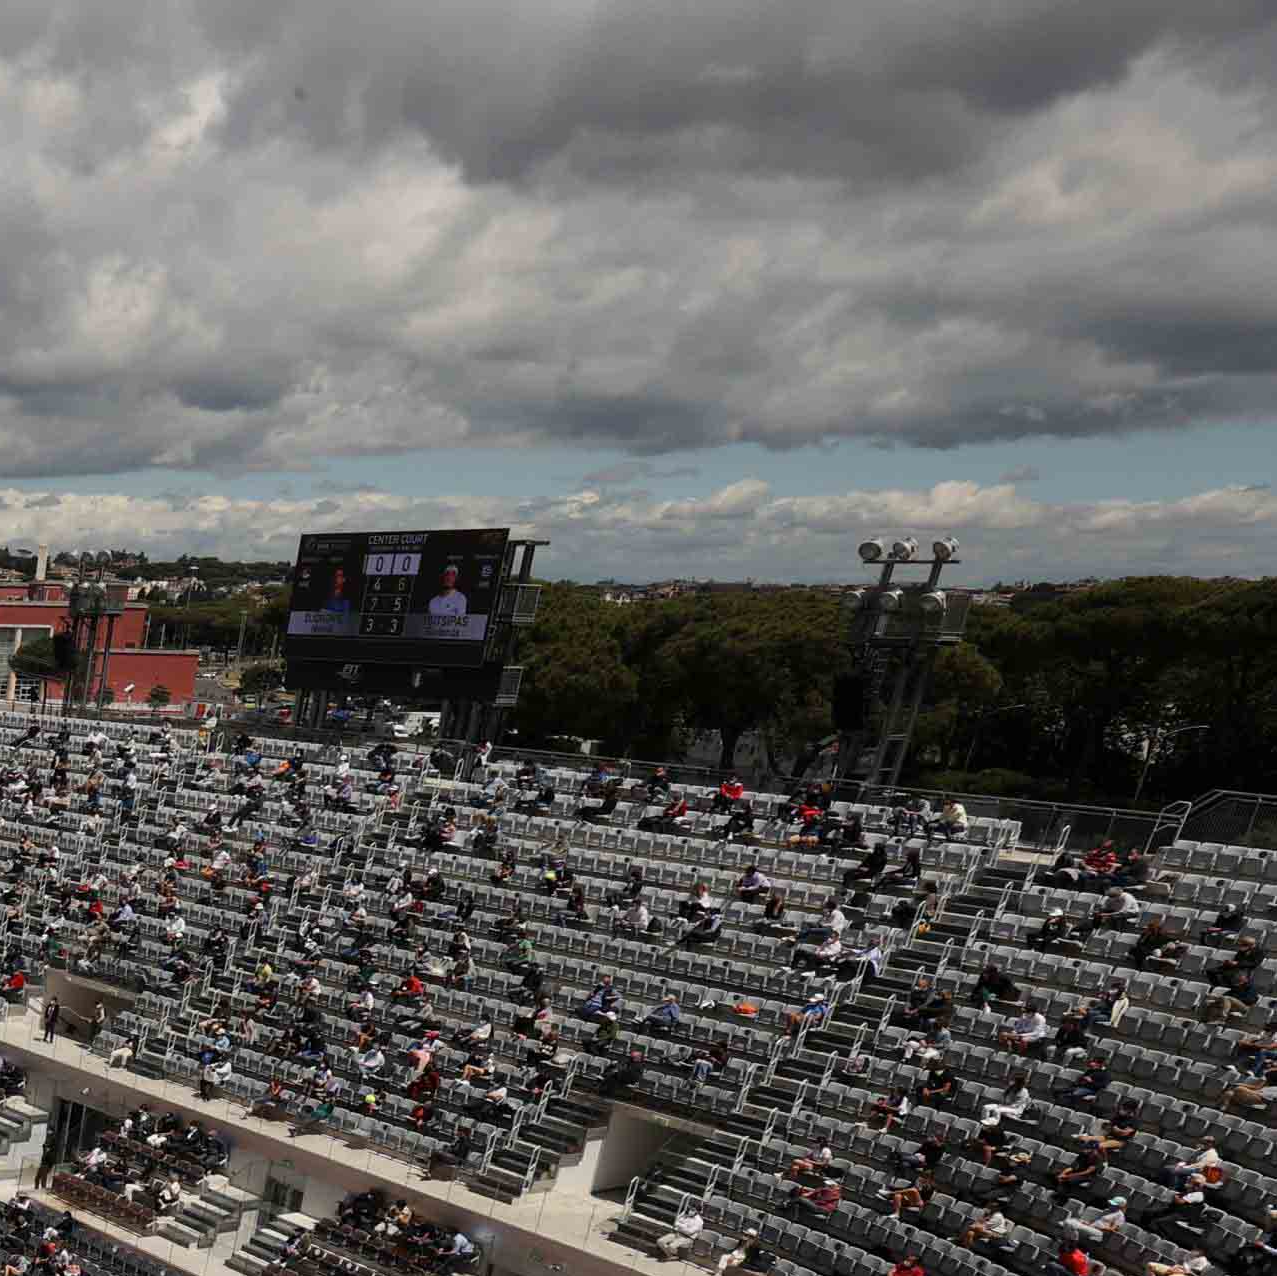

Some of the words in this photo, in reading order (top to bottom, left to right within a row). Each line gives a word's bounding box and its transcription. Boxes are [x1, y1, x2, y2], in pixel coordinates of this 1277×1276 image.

[368, 534, 399, 545] CENTER
[400, 533, 429, 544] COURT
[375, 556, 383, 572] 0
[402, 556, 411, 572] 0
[366, 617, 375, 633] 3
[390, 617, 400, 633] 3
